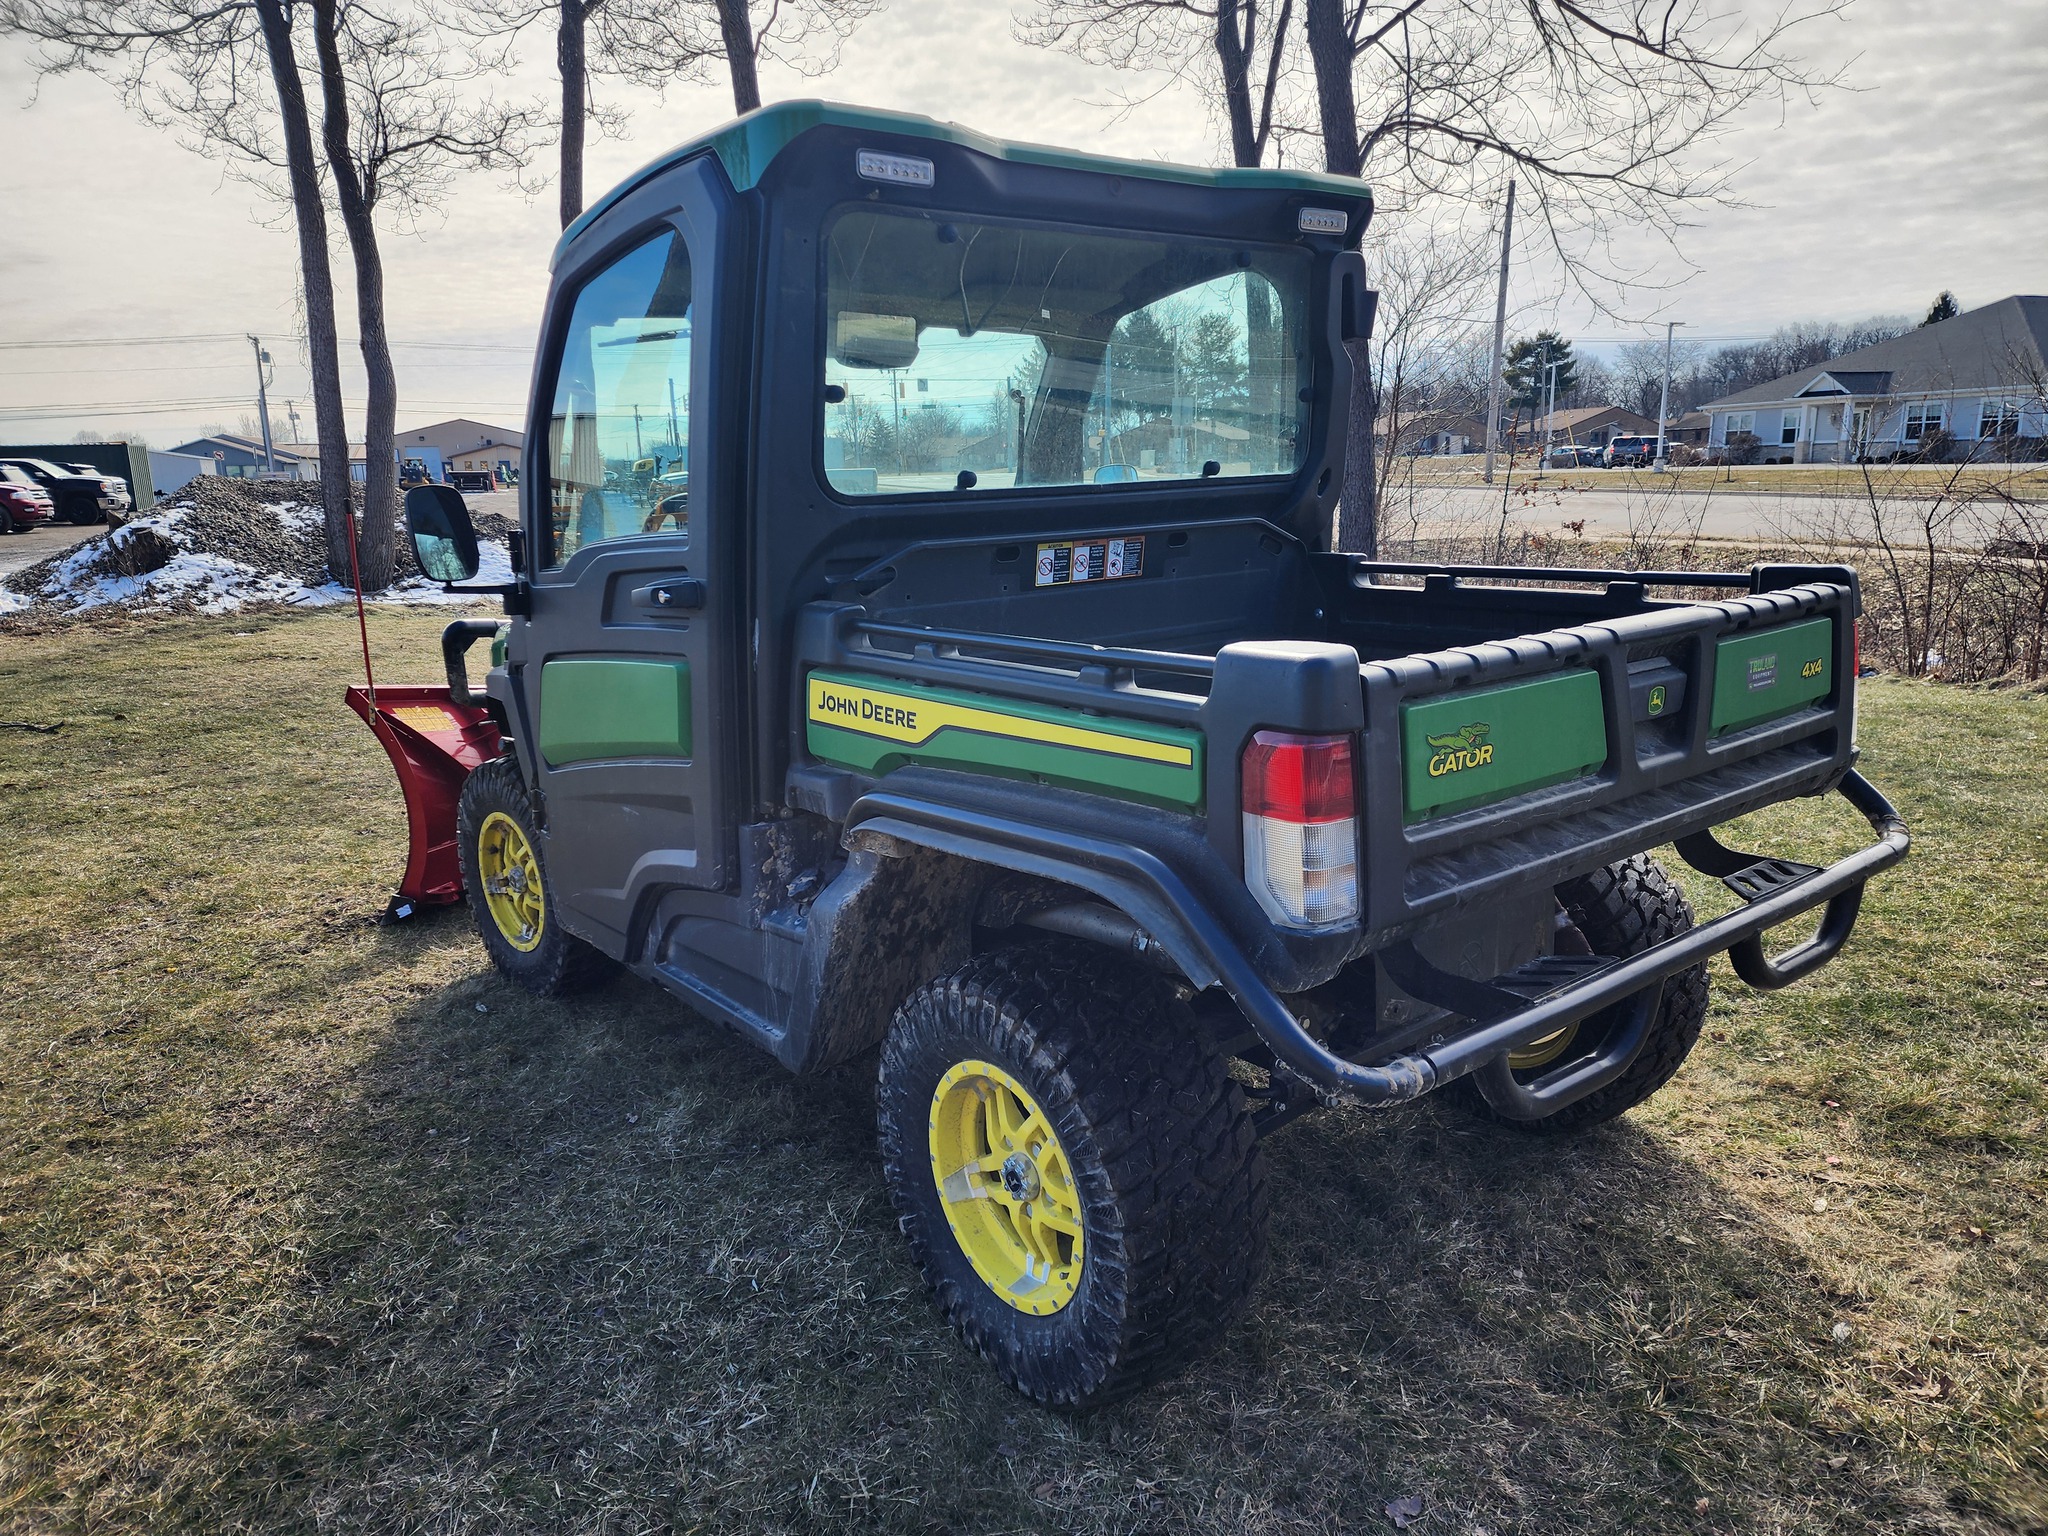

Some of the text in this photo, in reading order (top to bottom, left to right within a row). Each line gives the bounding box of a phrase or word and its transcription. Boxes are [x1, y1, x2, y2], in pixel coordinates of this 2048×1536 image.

[818, 690, 917, 730] JOHN DEERE
[1429, 744, 1494, 777] GATOR
